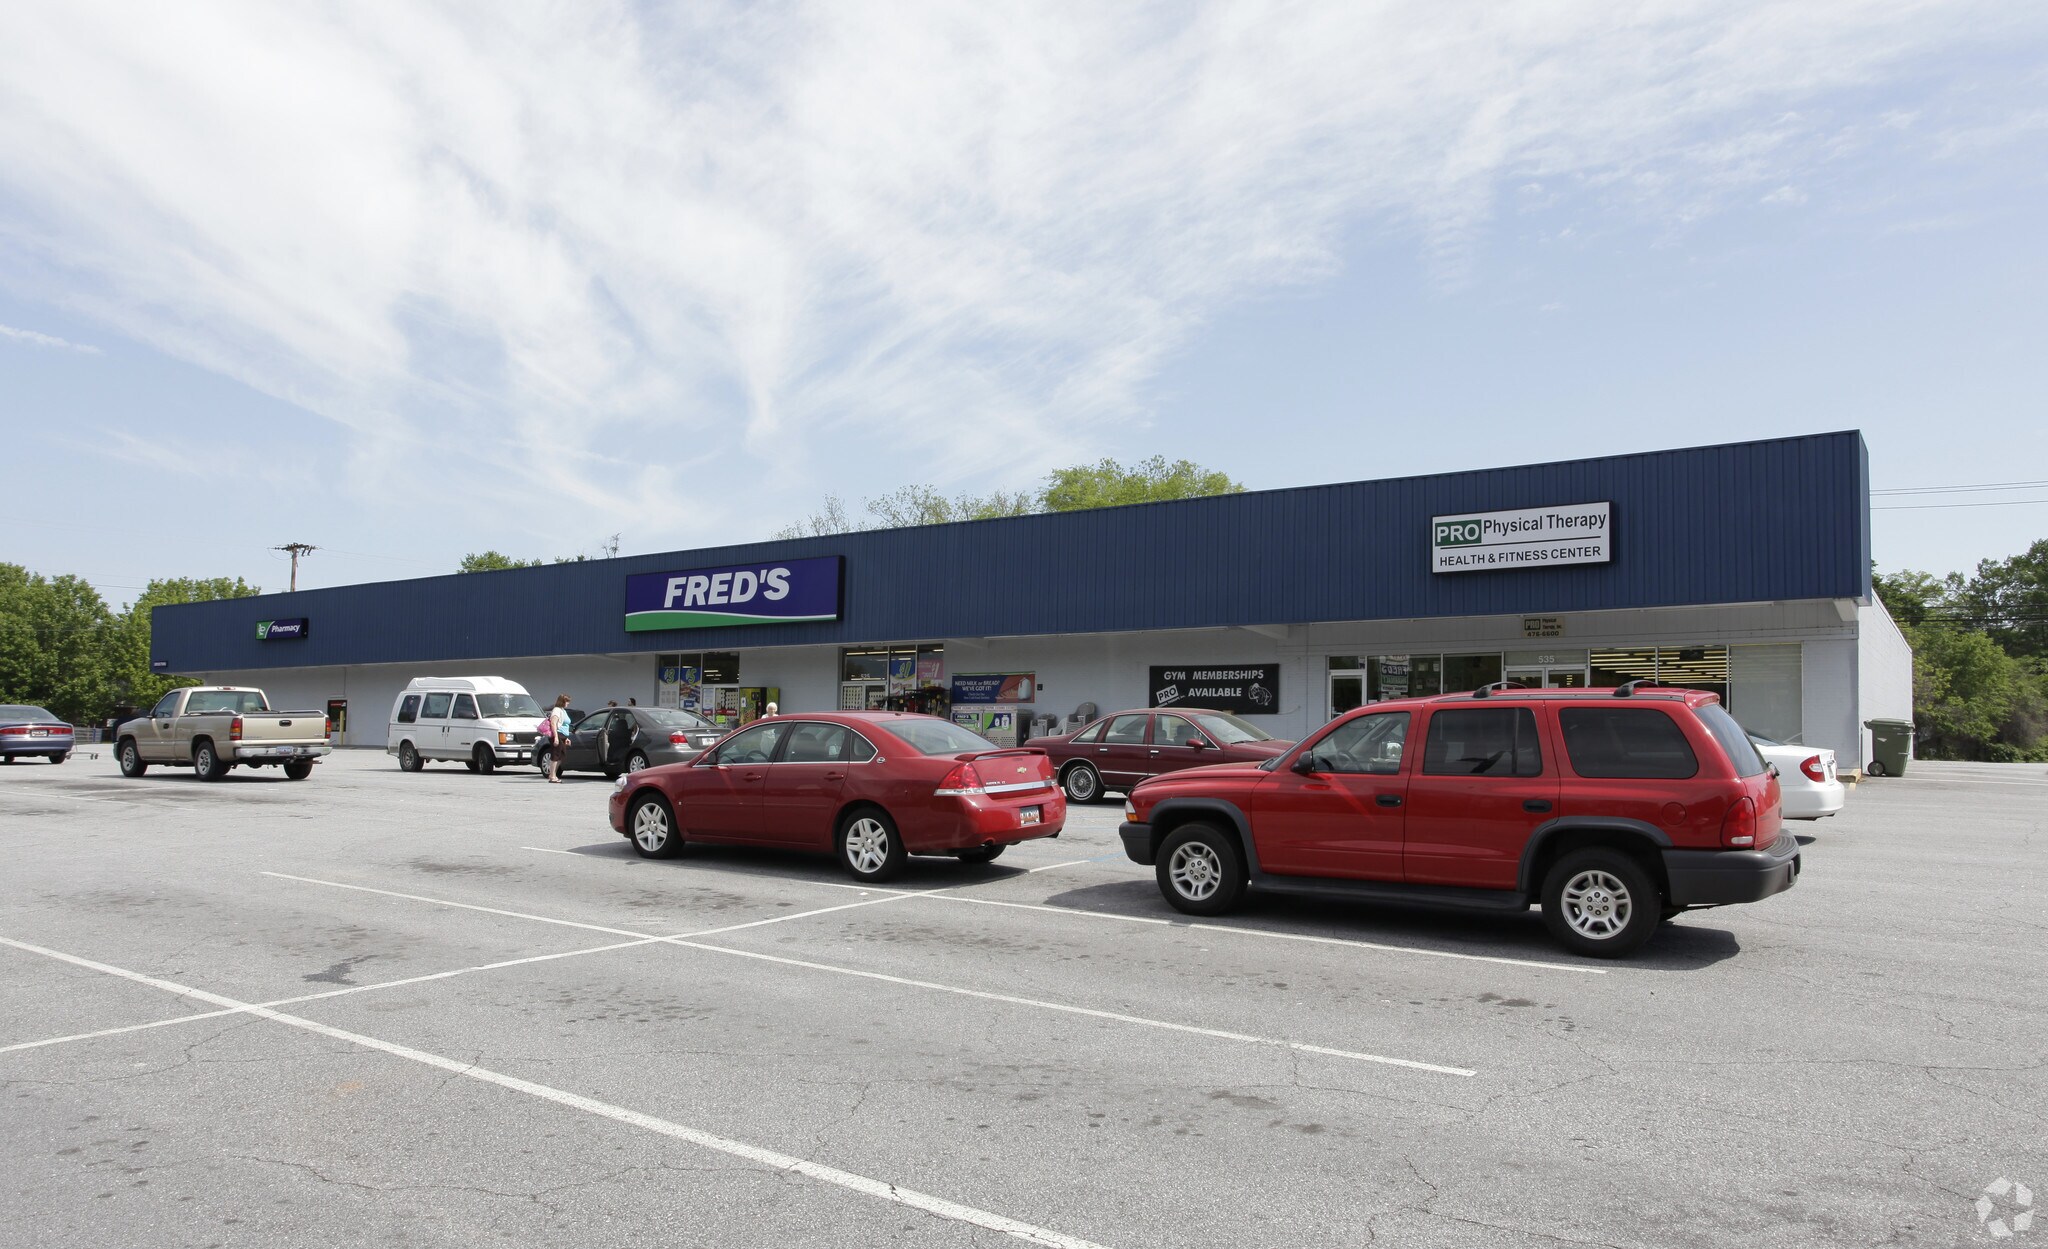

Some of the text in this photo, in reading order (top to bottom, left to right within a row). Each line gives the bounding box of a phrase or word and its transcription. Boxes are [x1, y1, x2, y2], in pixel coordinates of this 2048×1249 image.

[1436, 514, 1607, 542] PRO Physical Therapy
[1440, 546, 1601, 566] HEALTH & FITNESS CENTER
[663, 567, 791, 608] FRED'S
[271, 624, 301, 633] Pharmacy
[1525, 620, 1540, 629] PRO
[1538, 655, 1555, 663] 535
[1163, 669, 1264, 680] GYM MEMBERSHIPS
[1158, 687, 1177, 701] PRO
[1188, 687, 1242, 697] AVAILABLE
